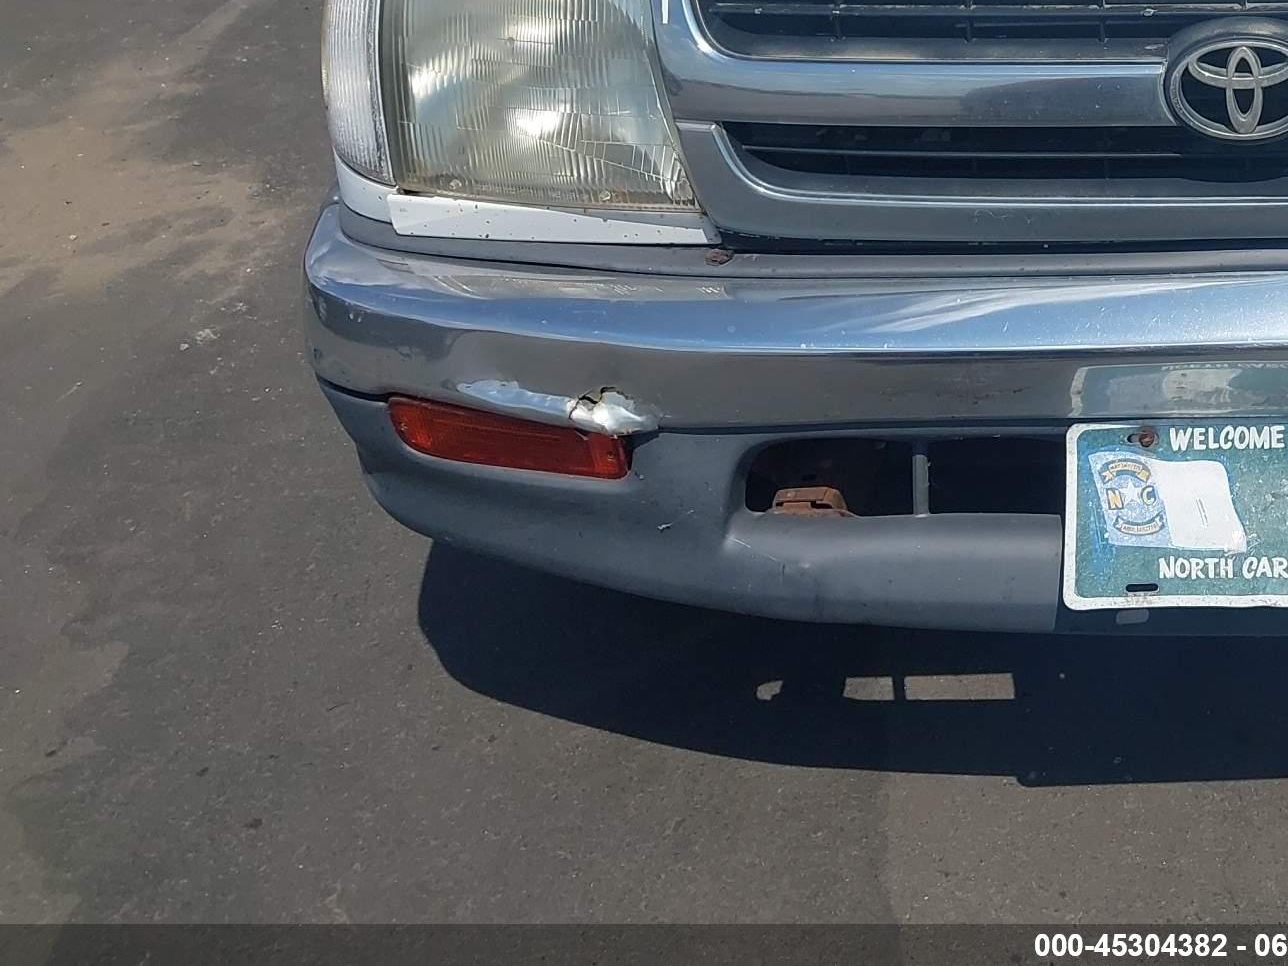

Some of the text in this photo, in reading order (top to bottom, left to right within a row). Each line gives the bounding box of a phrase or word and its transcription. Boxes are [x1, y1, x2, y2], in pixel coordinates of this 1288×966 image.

[1169, 424, 1285, 451] WELCOME
[1106, 485, 1157, 510] N C
[1158, 556, 1236, 580] NORTH
